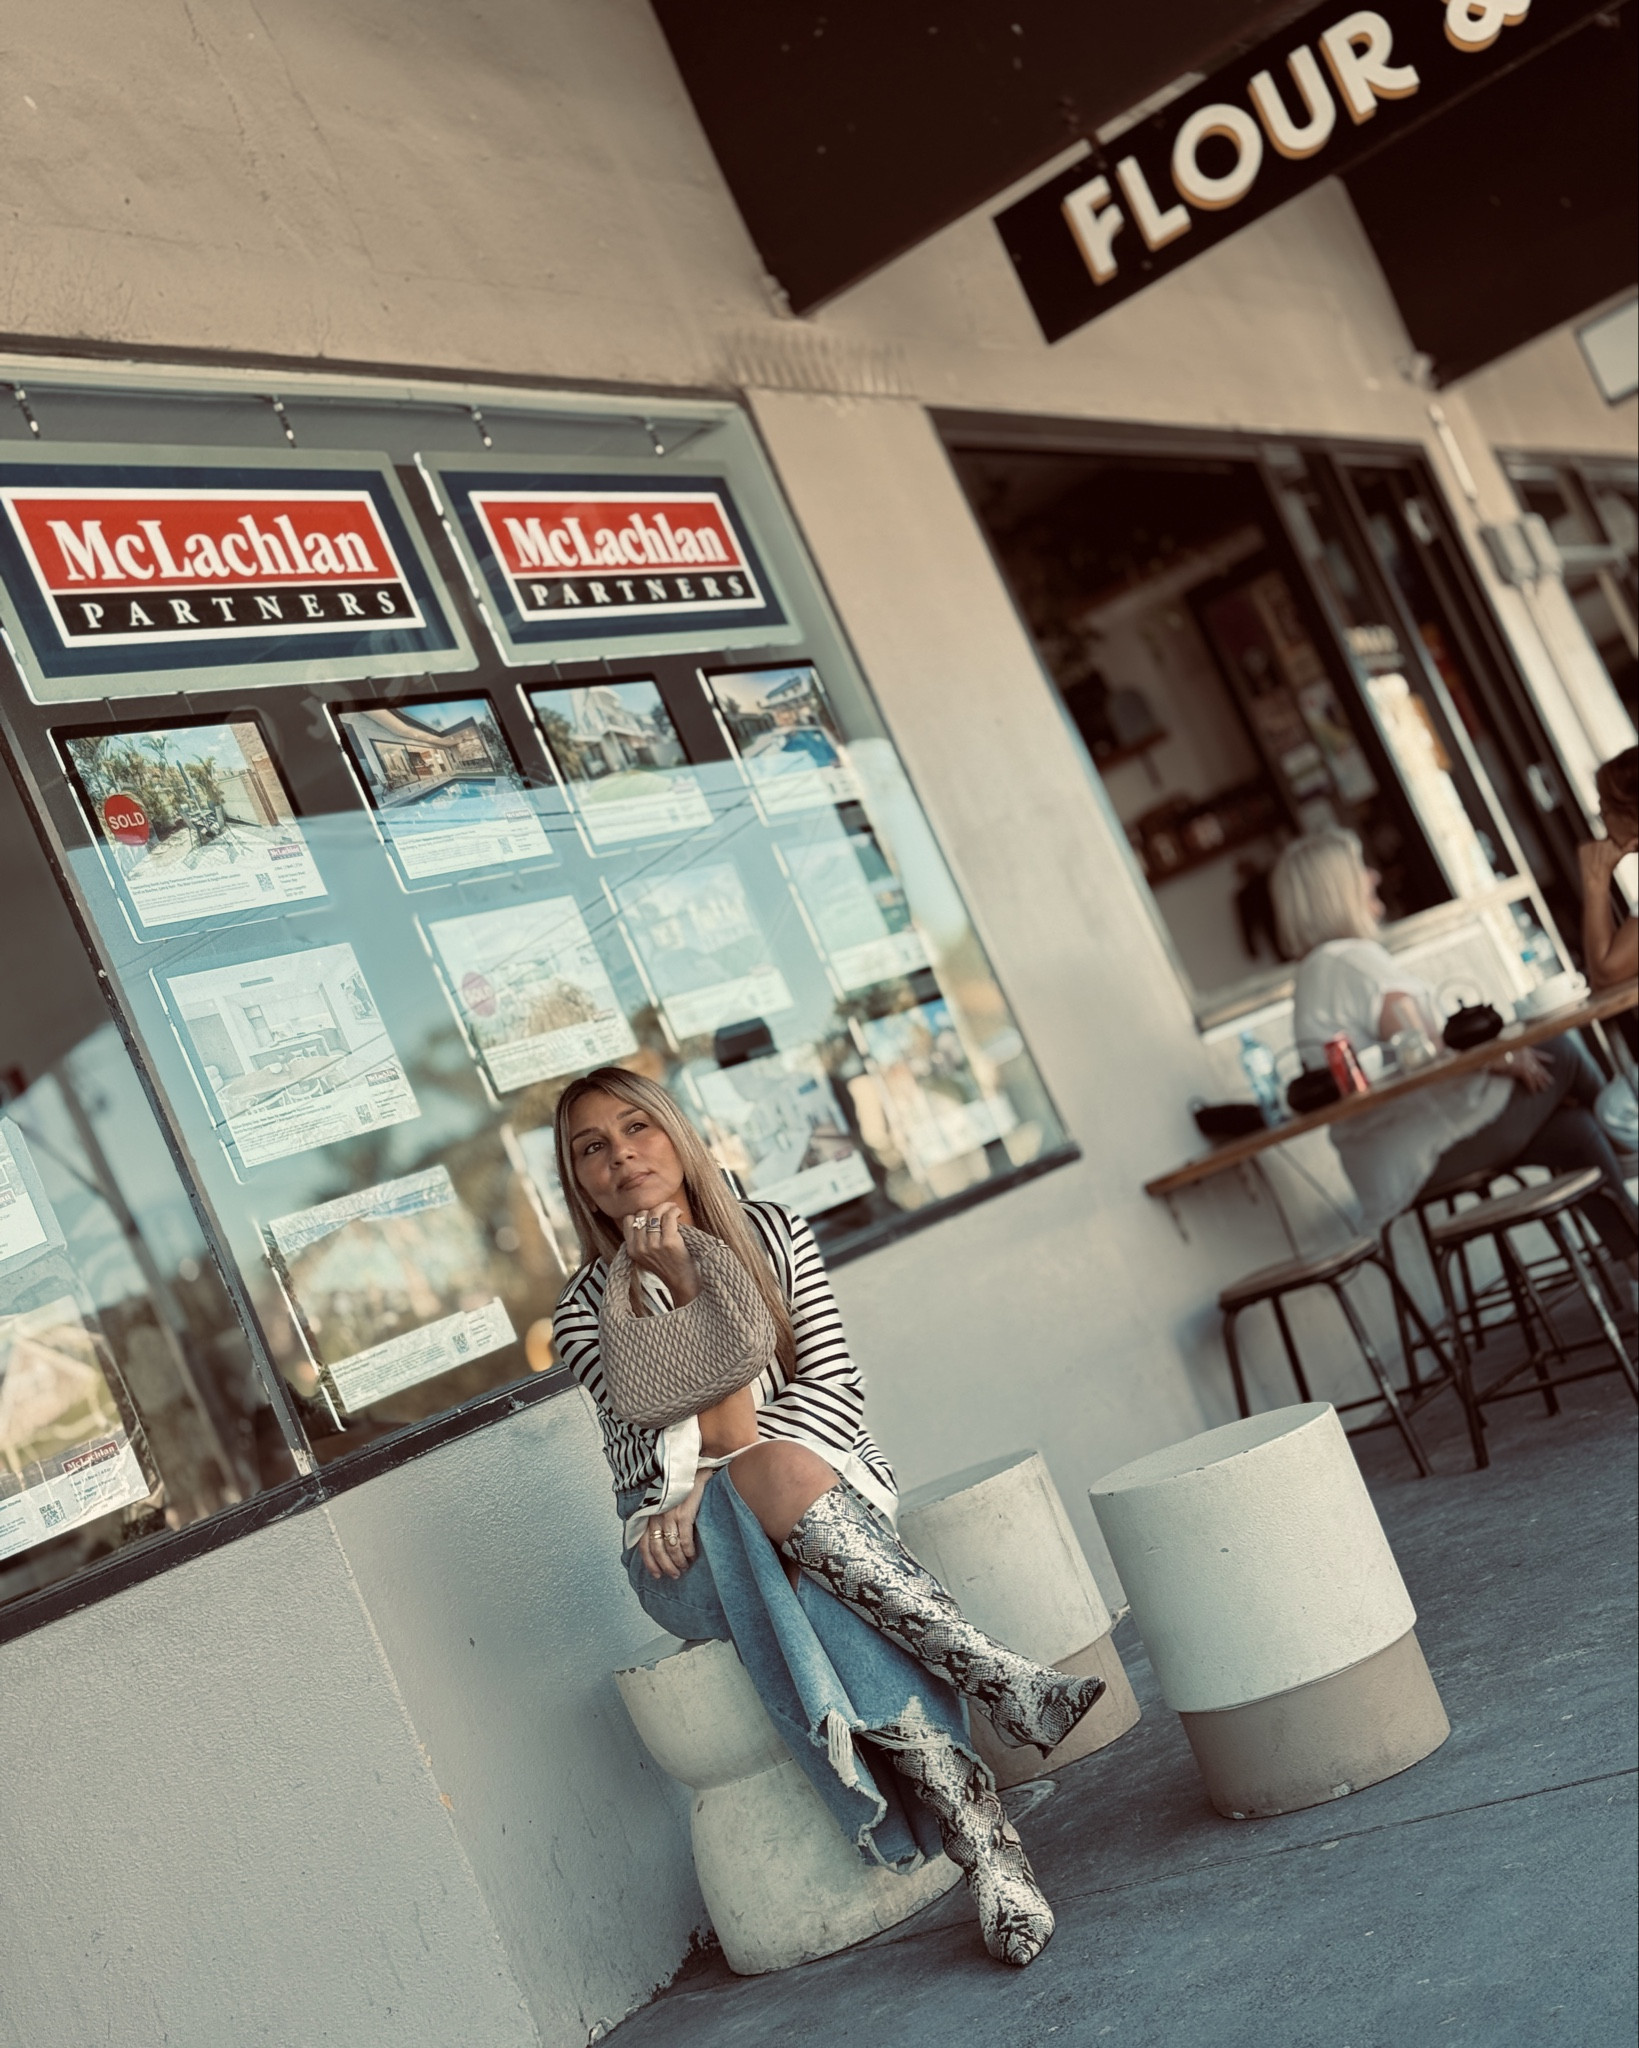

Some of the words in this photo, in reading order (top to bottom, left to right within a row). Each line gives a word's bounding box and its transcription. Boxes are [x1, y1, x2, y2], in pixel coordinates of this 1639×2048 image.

[1063, 11, 1420, 280] FLOUR
[46, 514, 379, 580] McLachlan
[502, 513, 730, 568] McLachlan
[80, 591, 396, 629] PARTNERS
[530, 576, 745, 606] PARTNERS
[108, 811, 145, 830] SOLD
[66, 1445, 116, 1471] McLachlan
